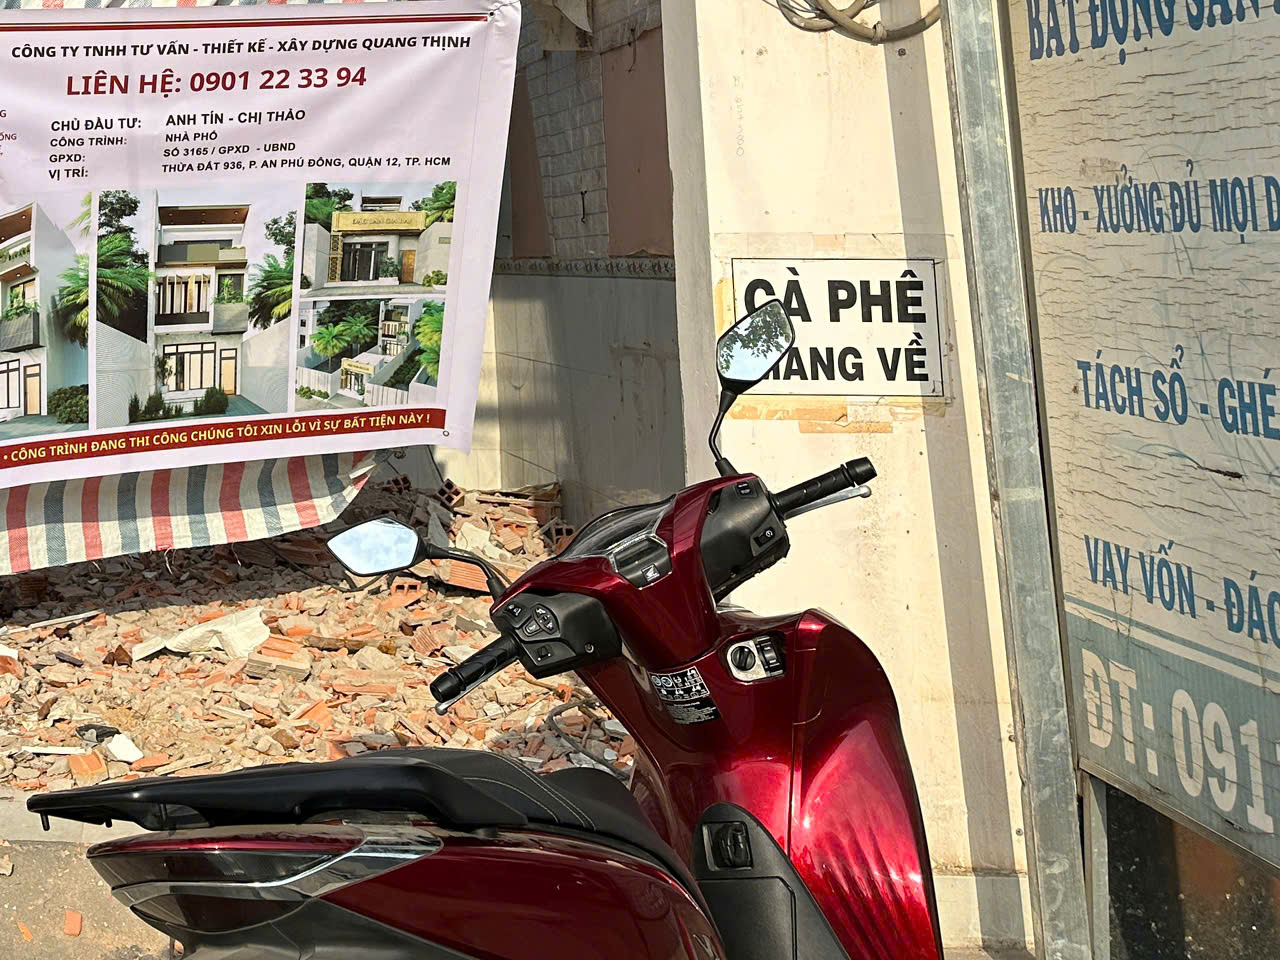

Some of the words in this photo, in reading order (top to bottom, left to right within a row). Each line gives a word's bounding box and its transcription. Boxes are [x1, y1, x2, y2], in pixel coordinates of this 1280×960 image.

[11, 44, 56, 58] CÔNG
[60, 46, 79, 57] TY
[83, 45, 127, 57] TNHH
[131, 44, 154, 56] TƯ
[157, 40, 190, 56] VẤN
[202, 39, 244, 55] THIẾT
[247, 38, 268, 53] KẾ
[277, 38, 308, 52] XÂY
[312, 37, 358, 54] DỰNG
[362, 37, 417, 51] QUANG
[421, 36, 471, 51] THỊNH
[66, 69, 129, 96] LIÊN
[139, 68, 182, 98] HỆ:
[189, 70, 250, 92] 0901
[259, 68, 290, 90] 22
[297, 67, 329, 89] 33
[336, 66, 367, 87] 94
[50, 117, 80, 132] CHỦ
[118, 117, 142, 129] TƯ:
[165, 113, 197, 126] ANH
[201, 110, 224, 125] TÍN
[237, 111, 262, 125] CHỊ
[266, 108, 306, 122] THẢO
[50, 136, 85, 147] CÔNG
[165, 131, 190, 142] NHÀ
[49, 153, 86, 163] GPXD:
[183, 147, 208, 157] 3165
[218, 145, 250, 155] GPXD
[264, 142, 296, 152] UBND
[223, 161, 246, 170] 936,
[260, 159, 277, 169] AN
[280, 156, 304, 168] PHÚ
[385, 157, 401, 167] 12,
[405, 157, 421, 166] TP.
[424, 156, 451, 166] HCM
[48, 169, 61, 181] VỊ
[1038, 186, 1076, 234] KHO
[1093, 163, 1166, 234] XƯỞNG
[1169, 158, 1201, 234] ĐỦ
[1208, 176, 1259, 245] MỌI
[744, 266, 812, 323] CÀ
[827, 269, 927, 324] PHÊ
[763, 346, 864, 382] ANG
[876, 332, 929, 382] VỀ
[1076, 349, 1145, 418] TÁCH
[1151, 344, 1189, 425] SỔ
[1218, 367, 1280, 441] GHÉ
[10, 444, 47, 462] CÔNG
[49, 440, 88, 457] TRÌNH
[91, 437, 126, 452] ĐANG
[129, 436, 150, 448] THI
[152, 430, 188, 446] CÔNG
[190, 426, 234, 442] CHÚNG
[237, 424, 258, 437] TÔI
[260, 423, 282, 436] XIN
[307, 416, 321, 432] VÌ
[324, 419, 341, 433] SỰ
[343, 413, 367, 428] BẤT
[369, 414, 396, 430] TIỆN
[398, 411, 424, 425] NÀY
[1083, 534, 1130, 596] VAY
[1138, 539, 1197, 619] VỐN
[1081, 647, 1159, 777] ĐT:
[1171, 689, 1280, 833] 091
